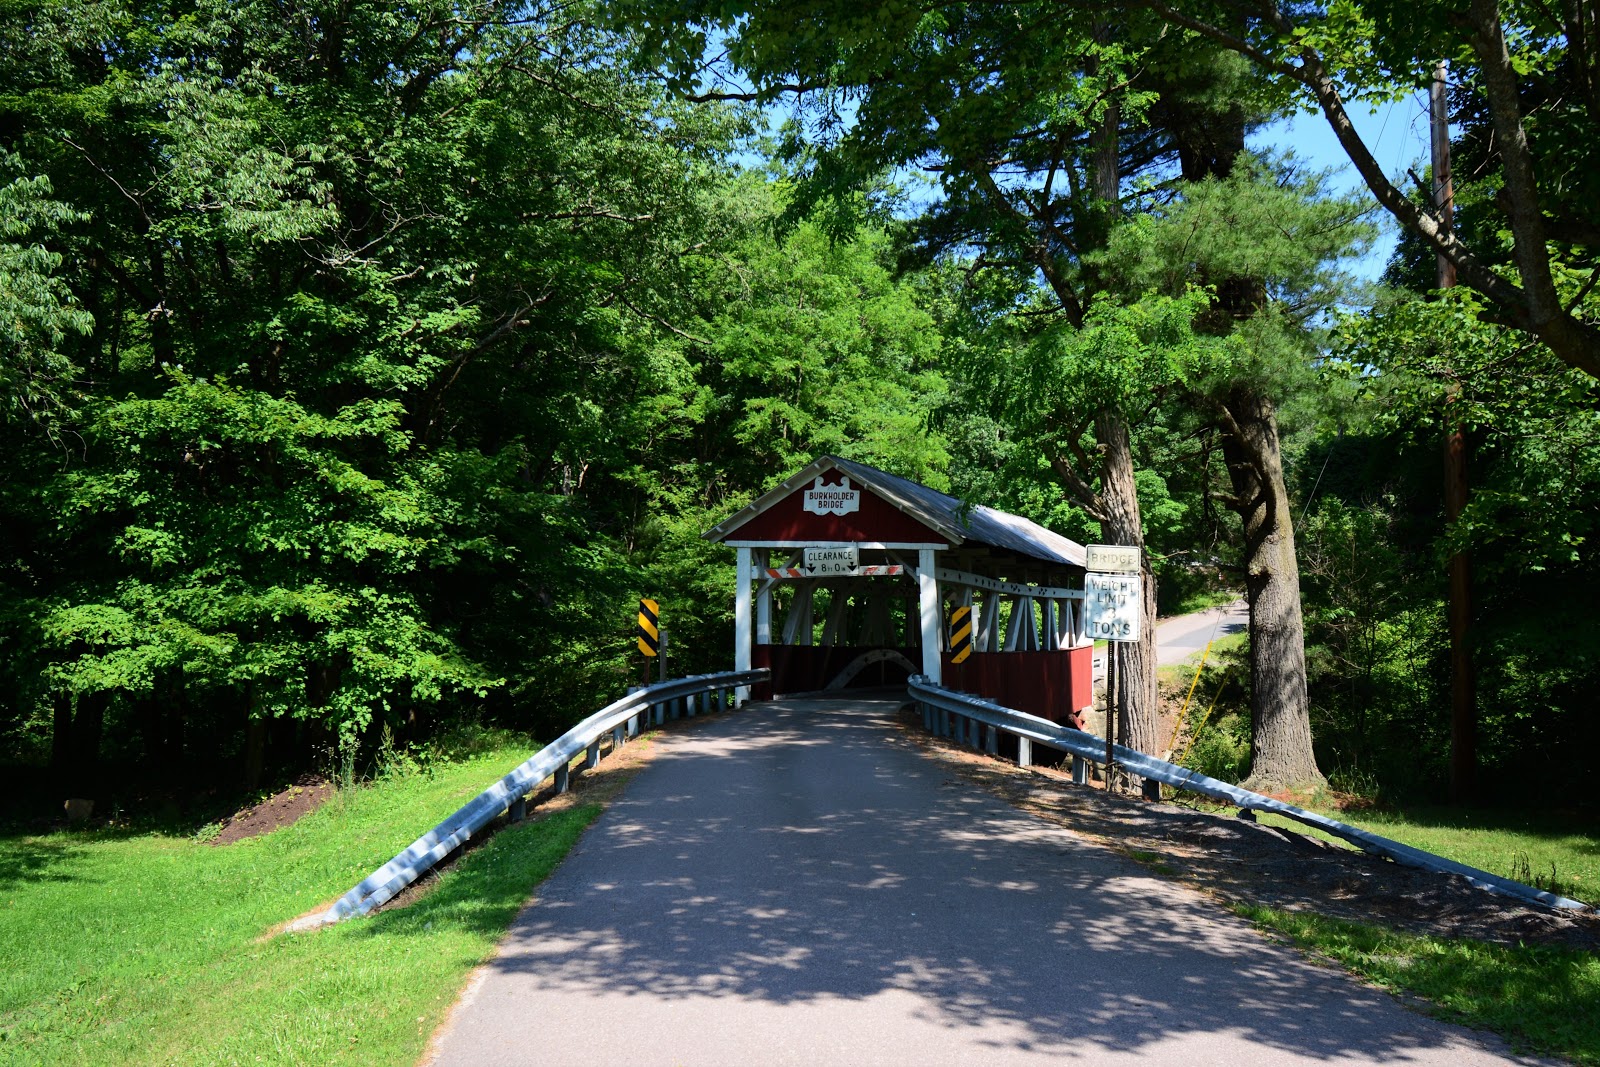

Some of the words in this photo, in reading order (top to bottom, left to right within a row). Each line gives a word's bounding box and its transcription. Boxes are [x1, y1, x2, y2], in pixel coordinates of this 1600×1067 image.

[809, 492, 854, 500] BURKHOLDER
[818, 500, 844, 508] BRIDGE
[809, 552, 852, 561] CLEARANCE
[1091, 553, 1135, 564] BRIDGE
[821, 564, 827, 572] 8
[1091, 579, 1135, 593] WEIGHT
[1097, 593, 1127, 604] LIMIT
[1107, 607, 1116, 619] 3
[1092, 622, 1130, 635] TONS
